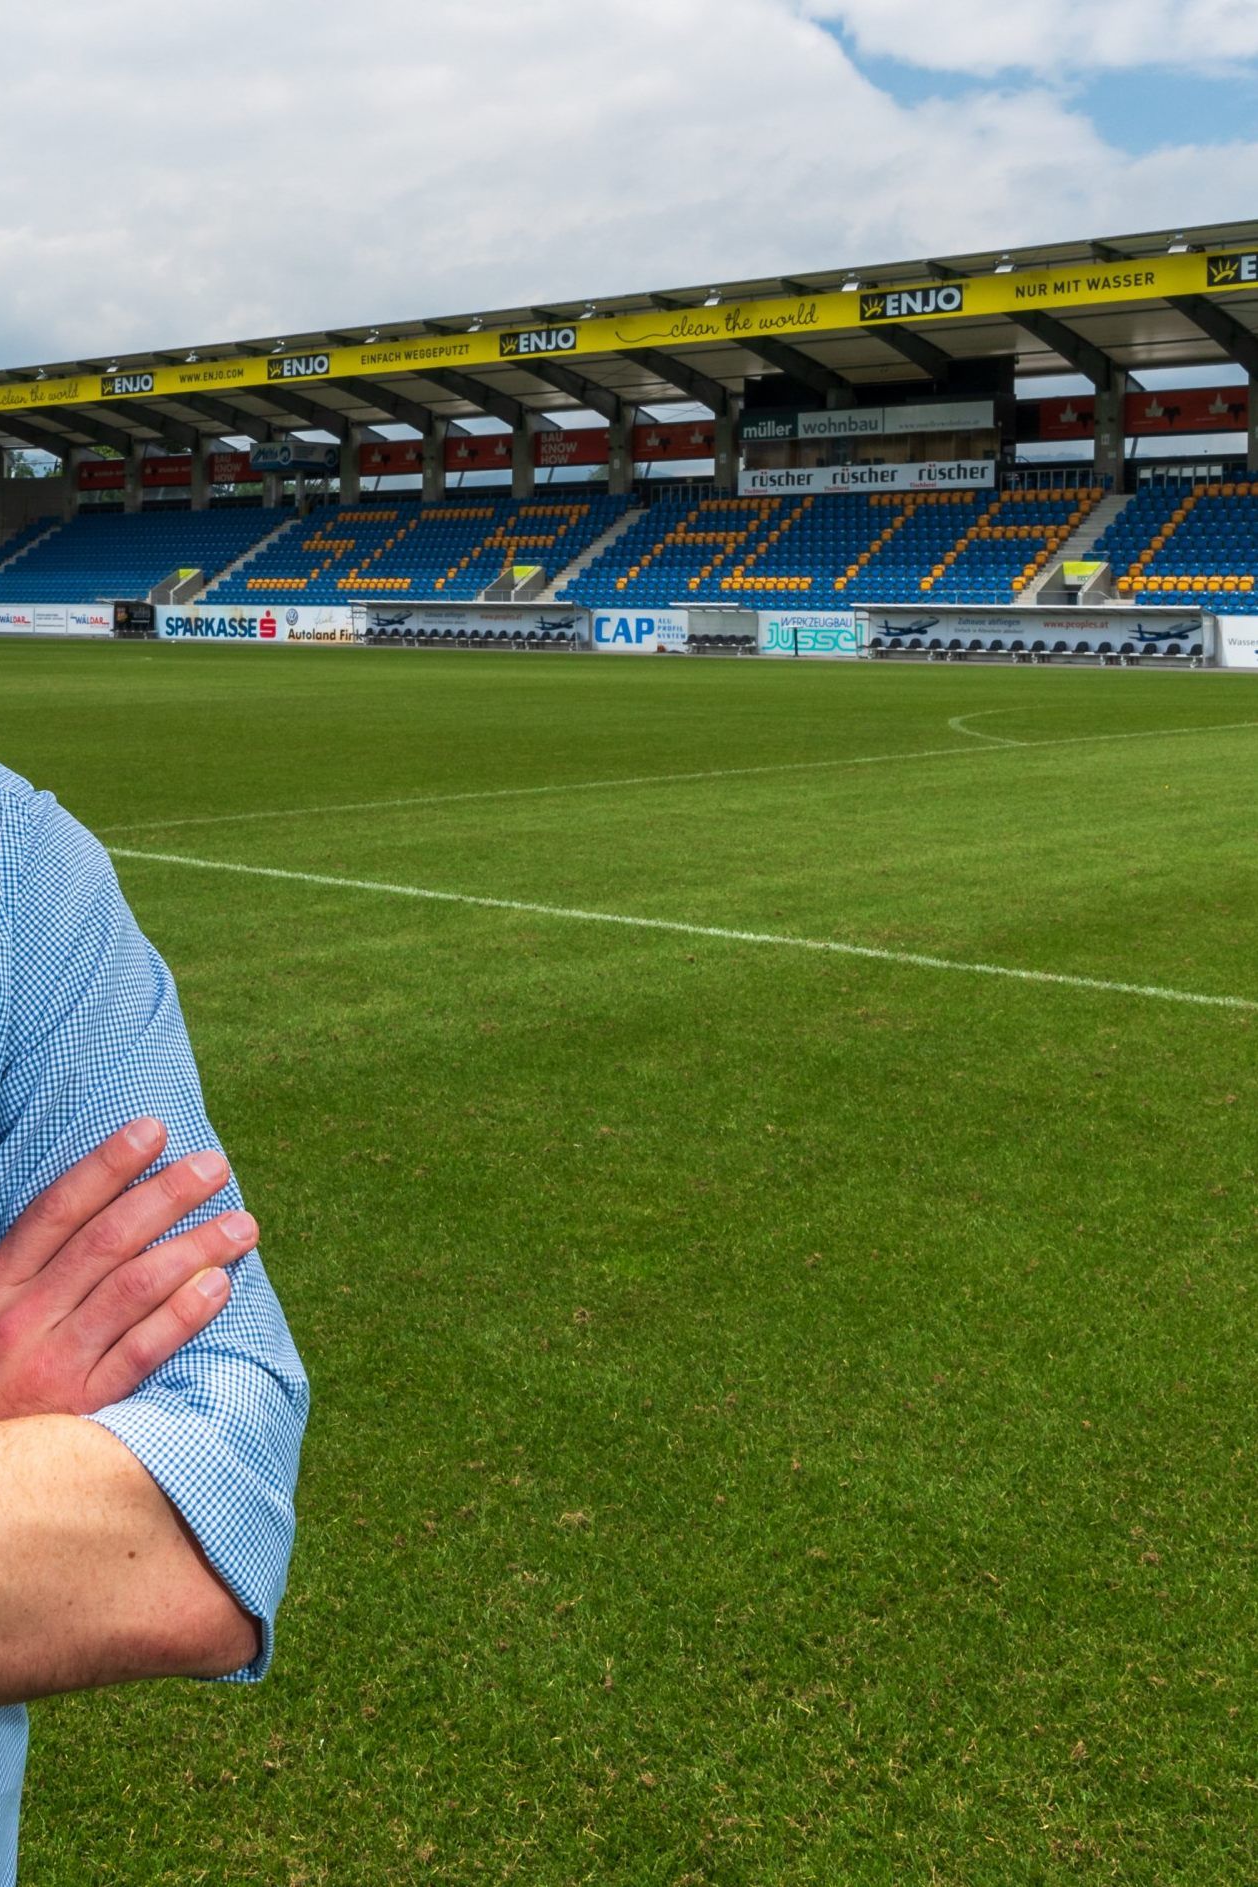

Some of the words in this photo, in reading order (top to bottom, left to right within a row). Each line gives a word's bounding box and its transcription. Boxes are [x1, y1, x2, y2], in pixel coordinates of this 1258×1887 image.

[1015, 284, 1047, 299] NUR
[1054, 280, 1080, 295] MIT
[1086, 272, 1155, 291] WASSER
[885, 286, 961, 316] ENJO
[670, 315, 720, 338] clean
[725, 308, 753, 334] the
[759, 302, 819, 328] world
[519, 328, 576, 353] ENJO
[361, 352, 401, 365] EINFACH
[404, 344, 470, 360] WEGGEPUTZT
[179, 368, 244, 384] WWW.ENJO.COM
[283, 355, 329, 377] ENJO
[30, 385, 45, 401] the
[48, 383, 79, 401] world
[114, 374, 153, 394] ENJO
[743, 421, 792, 438] müller
[802, 416, 879, 435] wohnbau
[541, 442, 578, 454] KNOW
[541, 454, 570, 465] HOW
[751, 471, 814, 487] rüscher
[832, 467, 899, 485] rüscher
[918, 463, 989, 481] rüscher
[165, 616, 257, 638] SPARKASSE
[595, 616, 655, 644] CAP
[780, 617, 852, 628] WERKZEUGBAU
[288, 628, 336, 641] Autoland
